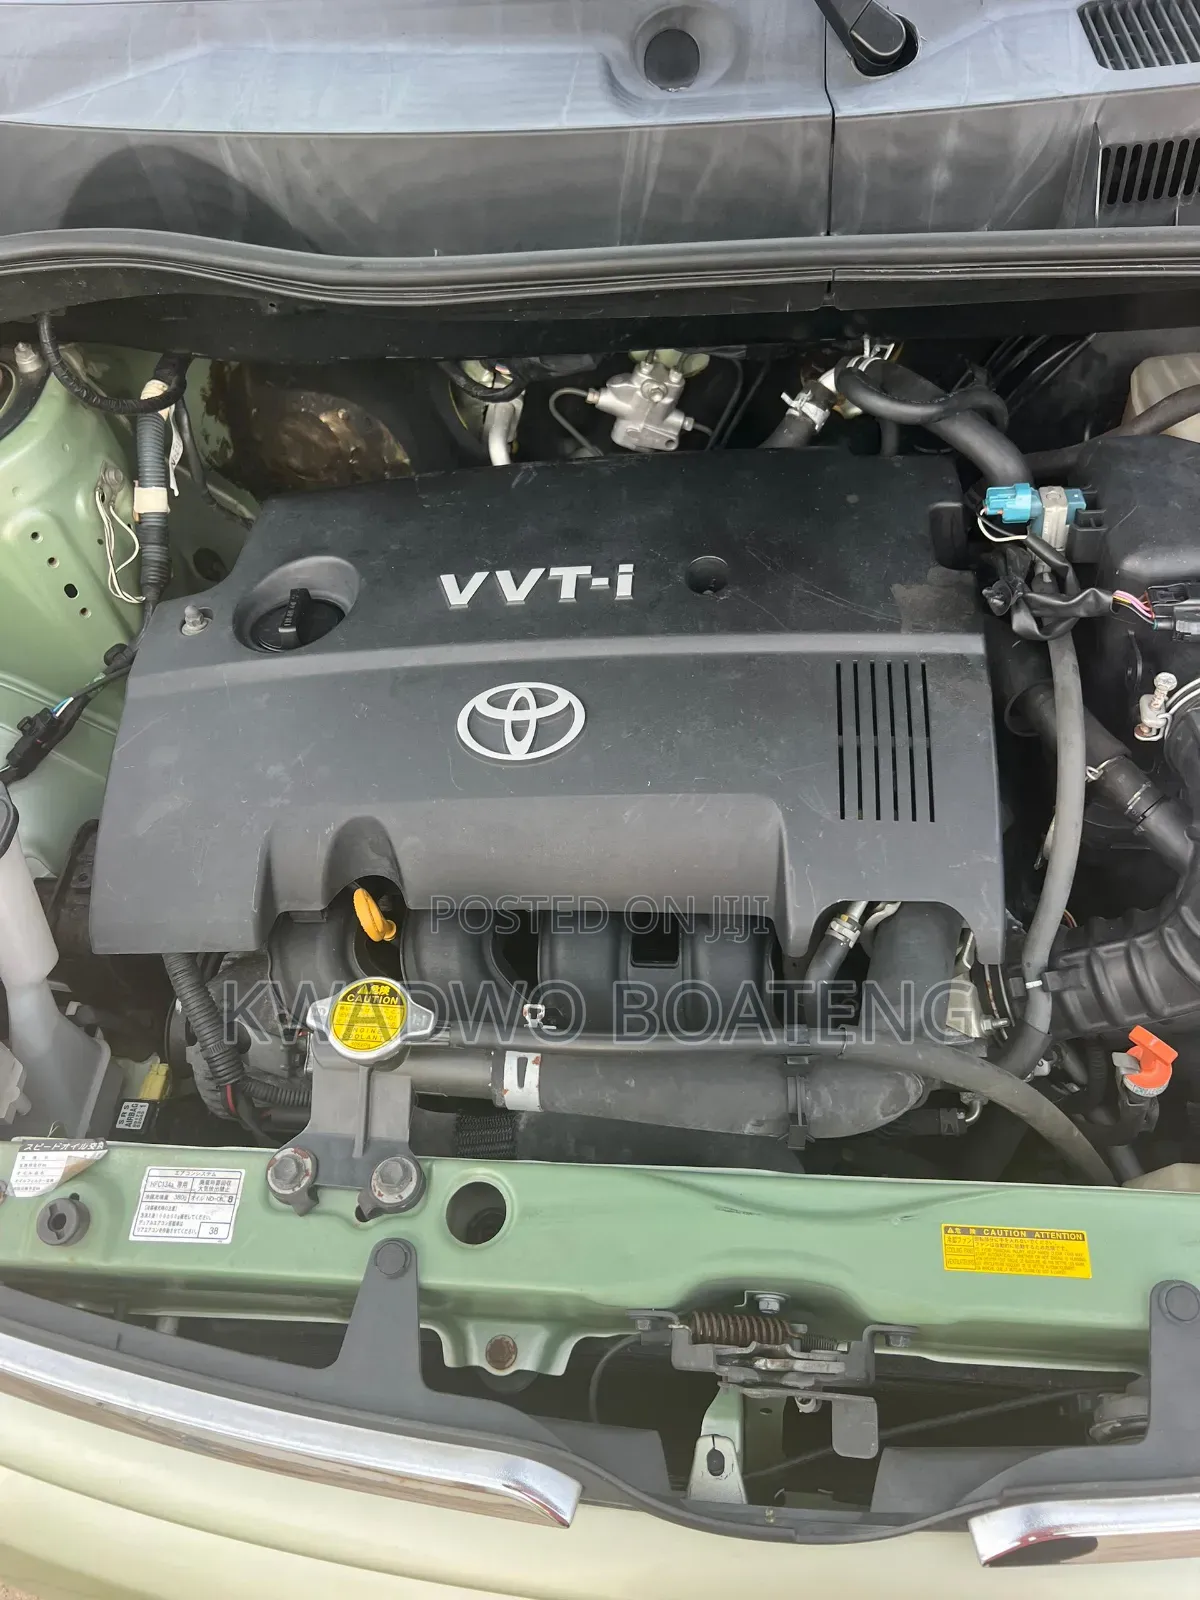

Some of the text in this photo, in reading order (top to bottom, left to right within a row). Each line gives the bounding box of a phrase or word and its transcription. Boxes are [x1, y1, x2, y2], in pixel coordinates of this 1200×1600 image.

[438, 563, 635, 609] VVT-i
[346, 994, 399, 1005] CAUTION
[346, 1027, 383, 1035] ENGINE
[342, 1032, 383, 1041] COOLANT
[125, 1103, 139, 1128] AIRBAG
[227, 1195, 234, 1203] 8
[208, 1226, 219, 1235] 38
[983, 1228, 1027, 1238] CAUTION
[1034, 1231, 1084, 1241] ATTENTION
